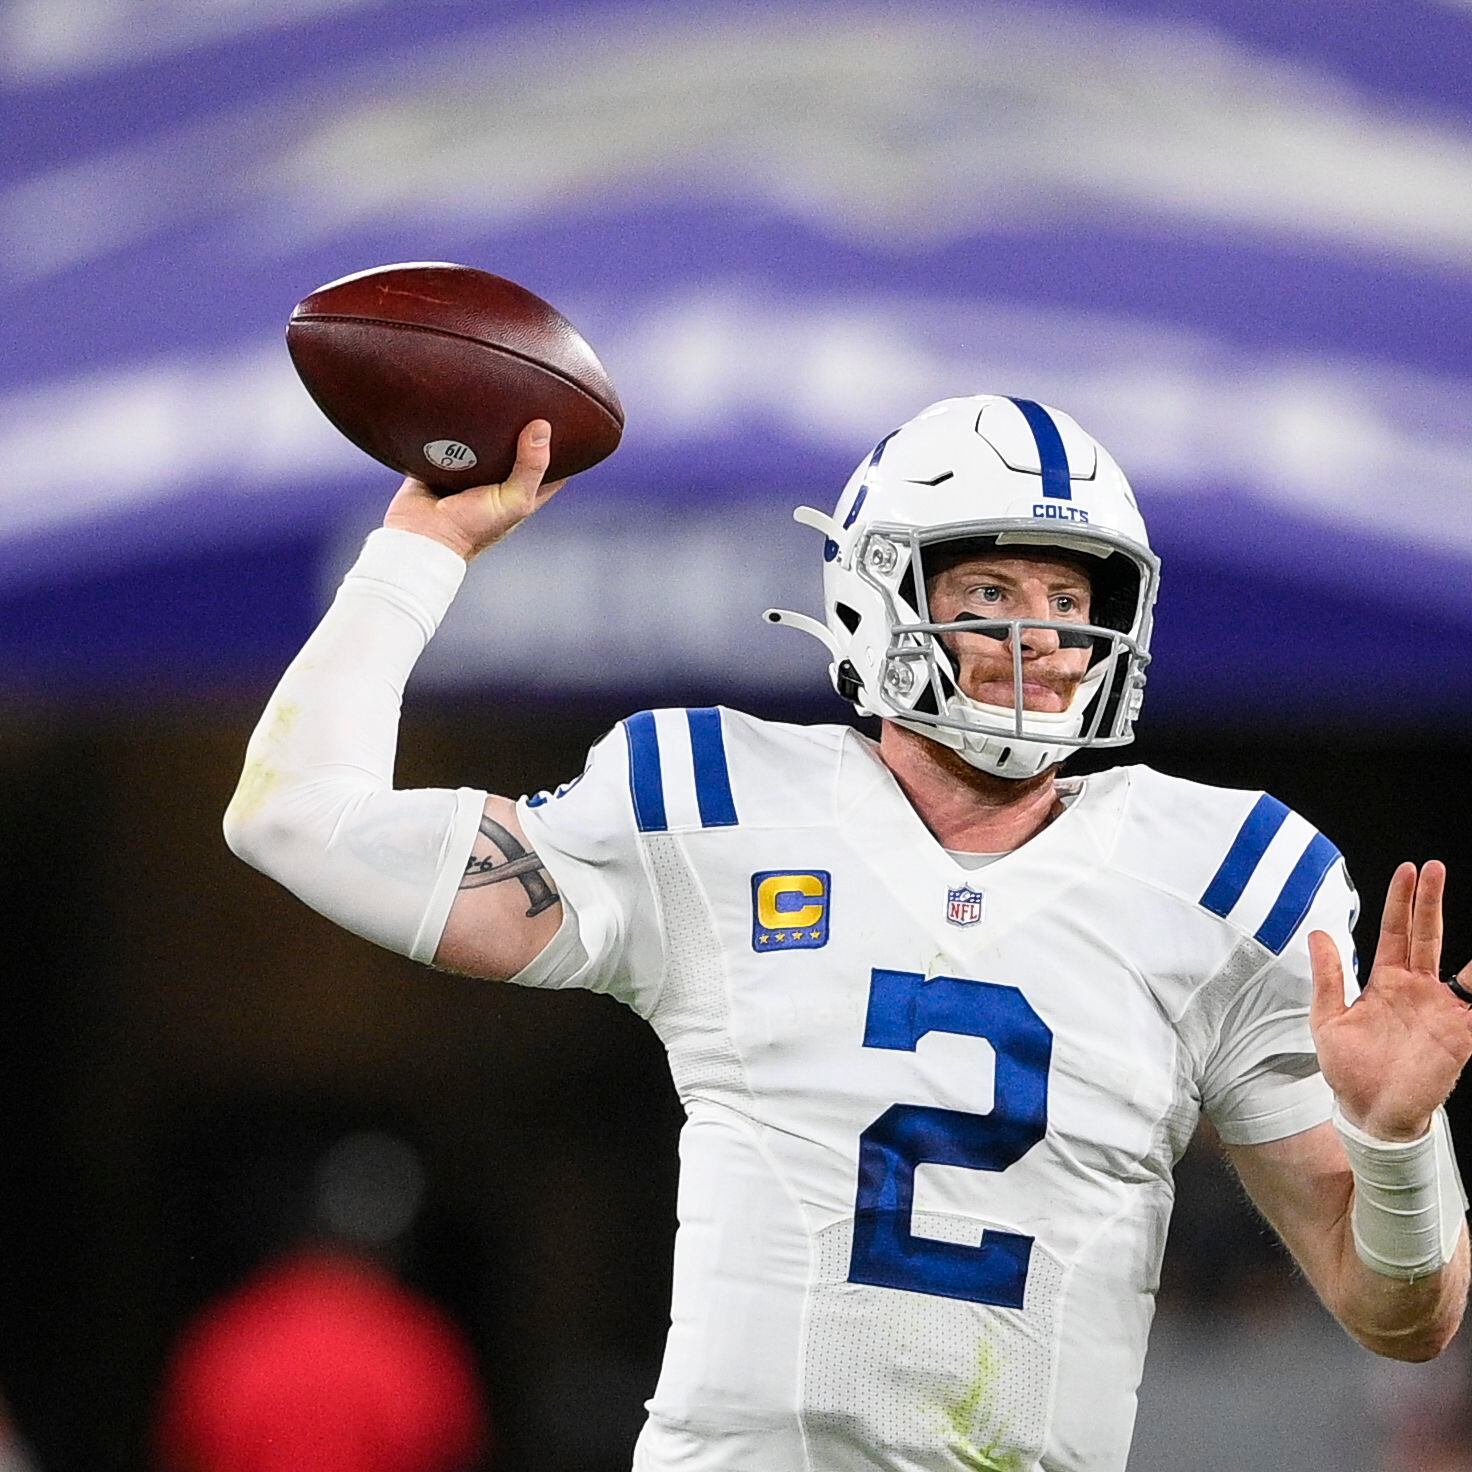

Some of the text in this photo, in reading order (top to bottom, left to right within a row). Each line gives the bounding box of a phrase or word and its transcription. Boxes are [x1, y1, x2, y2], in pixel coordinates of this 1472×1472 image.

[1032, 504, 1089, 523] COLTS
[757, 875, 824, 930] C
[949, 902, 978, 921] NFL
[847, 967, 1053, 1310] 2
